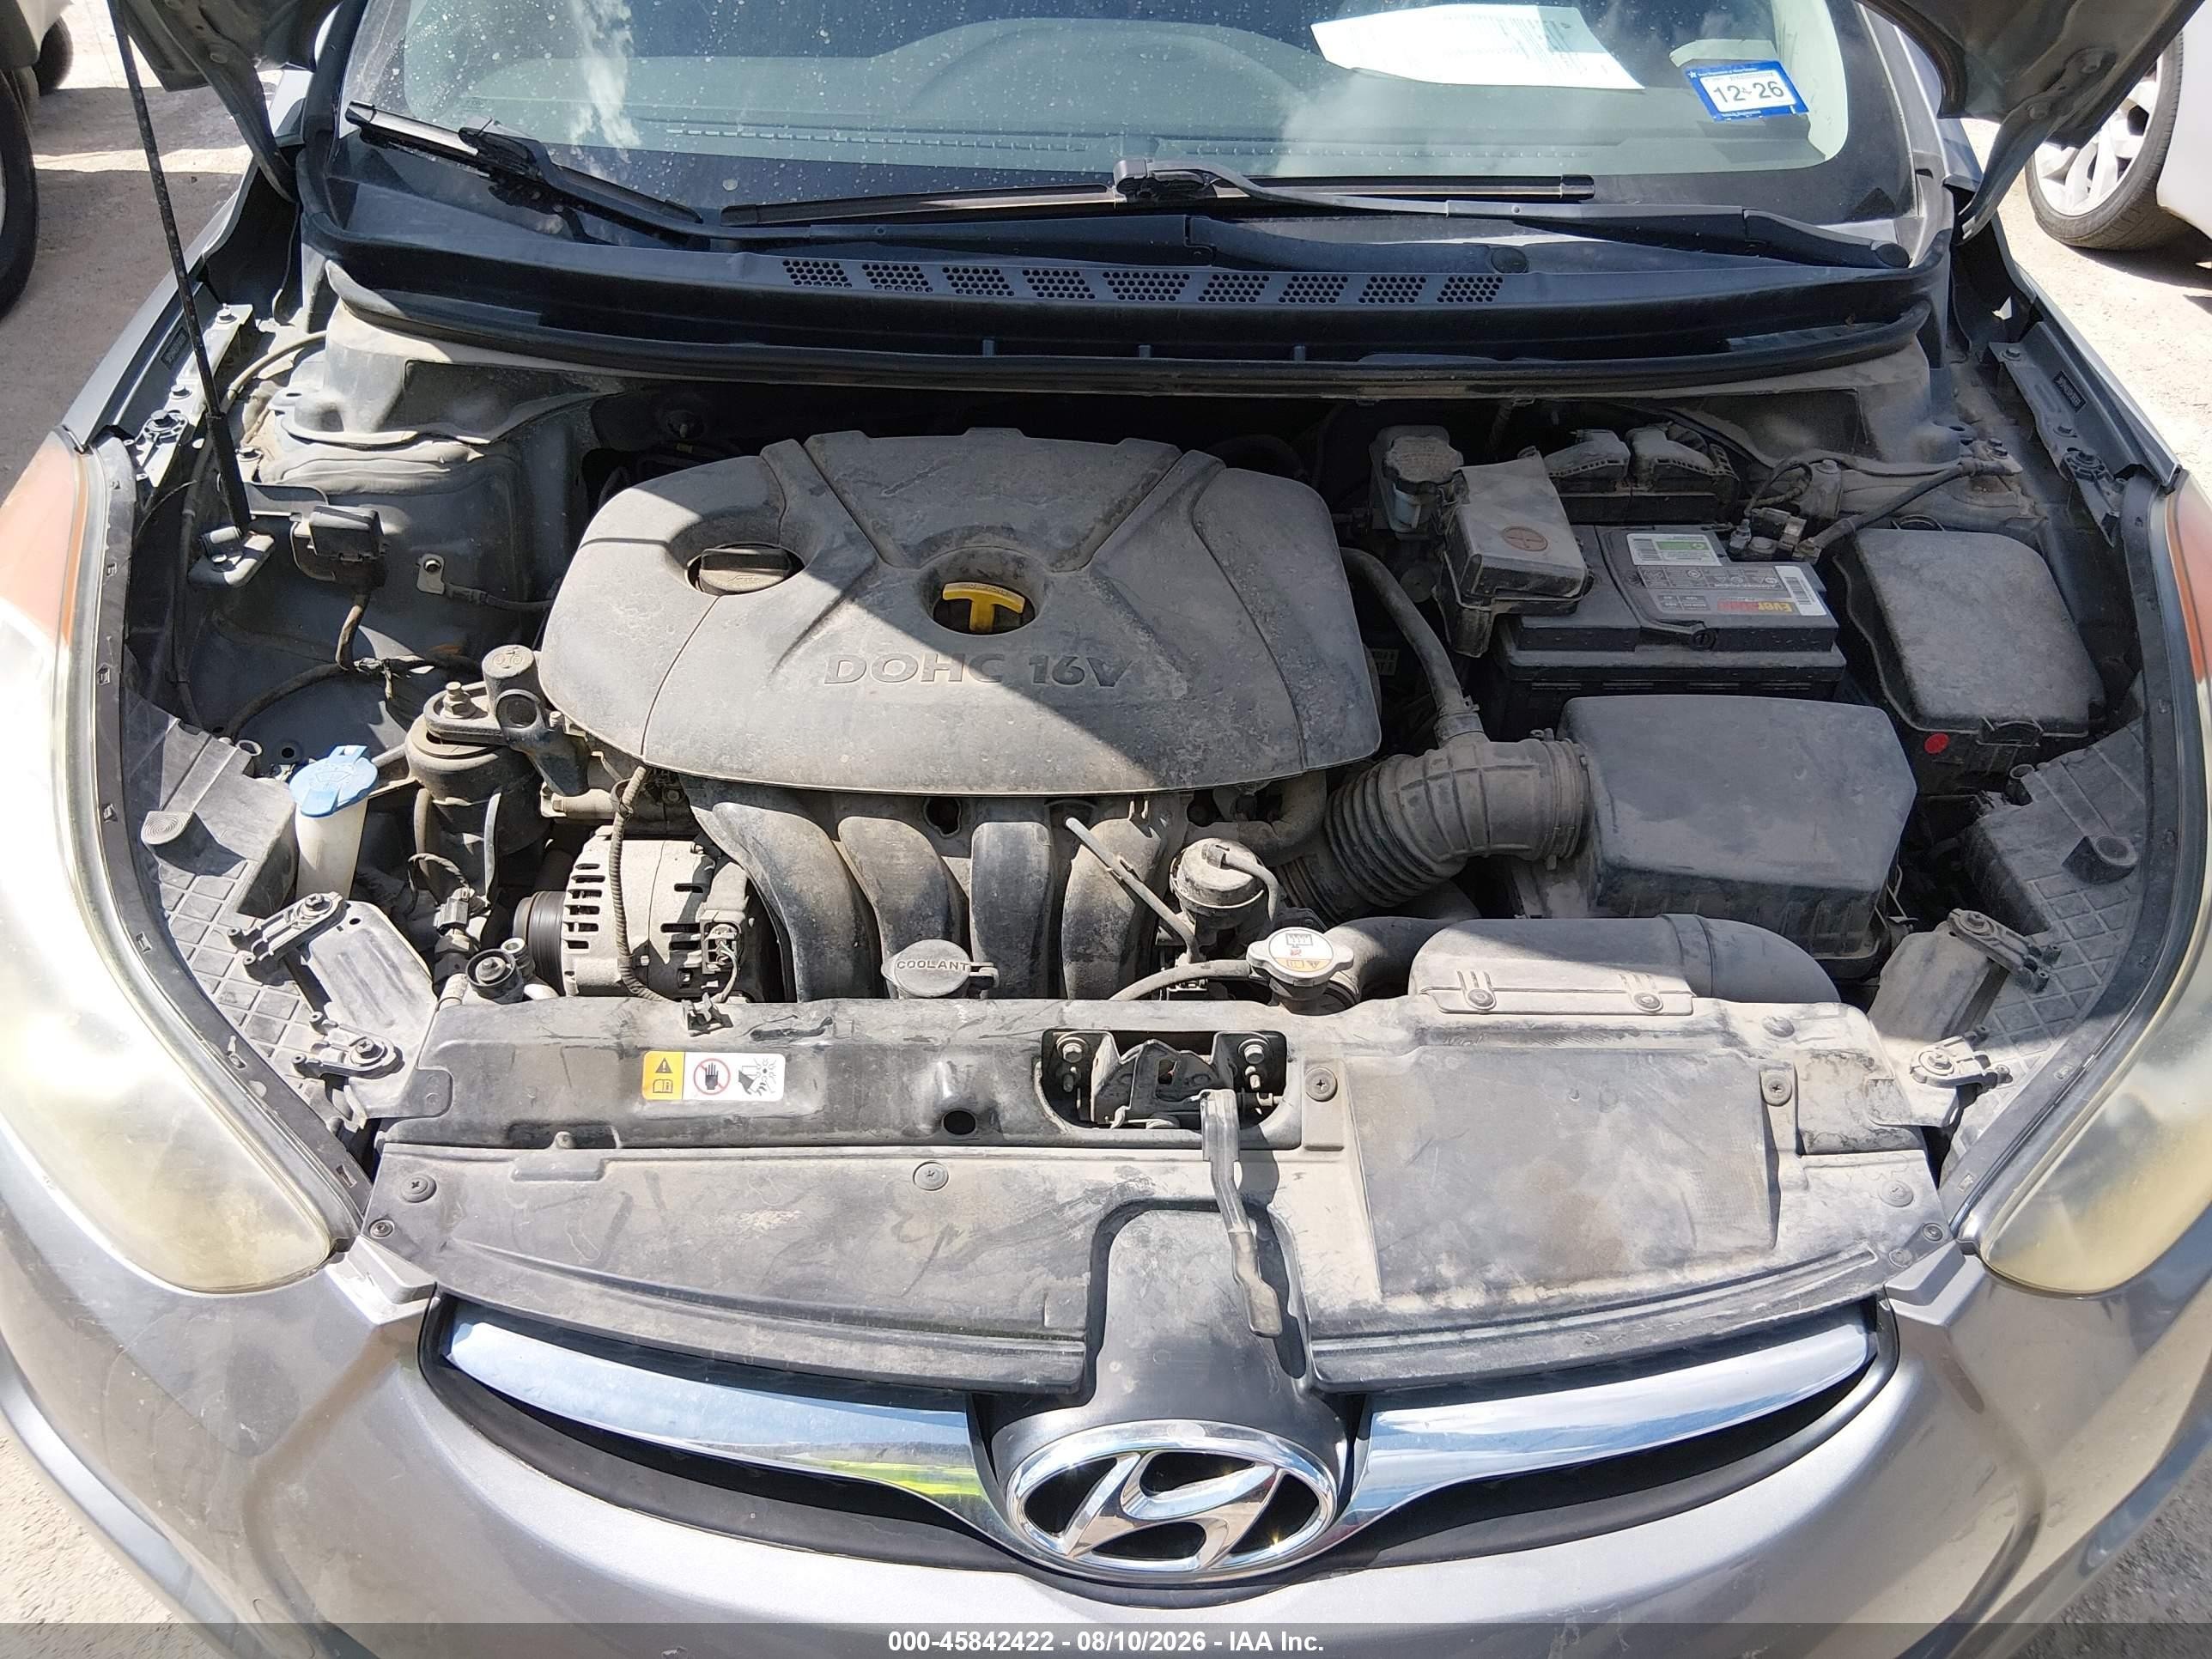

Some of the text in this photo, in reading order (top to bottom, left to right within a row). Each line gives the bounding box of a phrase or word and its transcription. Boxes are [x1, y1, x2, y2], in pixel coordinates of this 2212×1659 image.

[1713, 84, 1746, 103] 12
[1753, 81, 1784, 99] 26
[824, 653, 1133, 688] DOHC 16V
[896, 960, 969, 971] COOLANT
